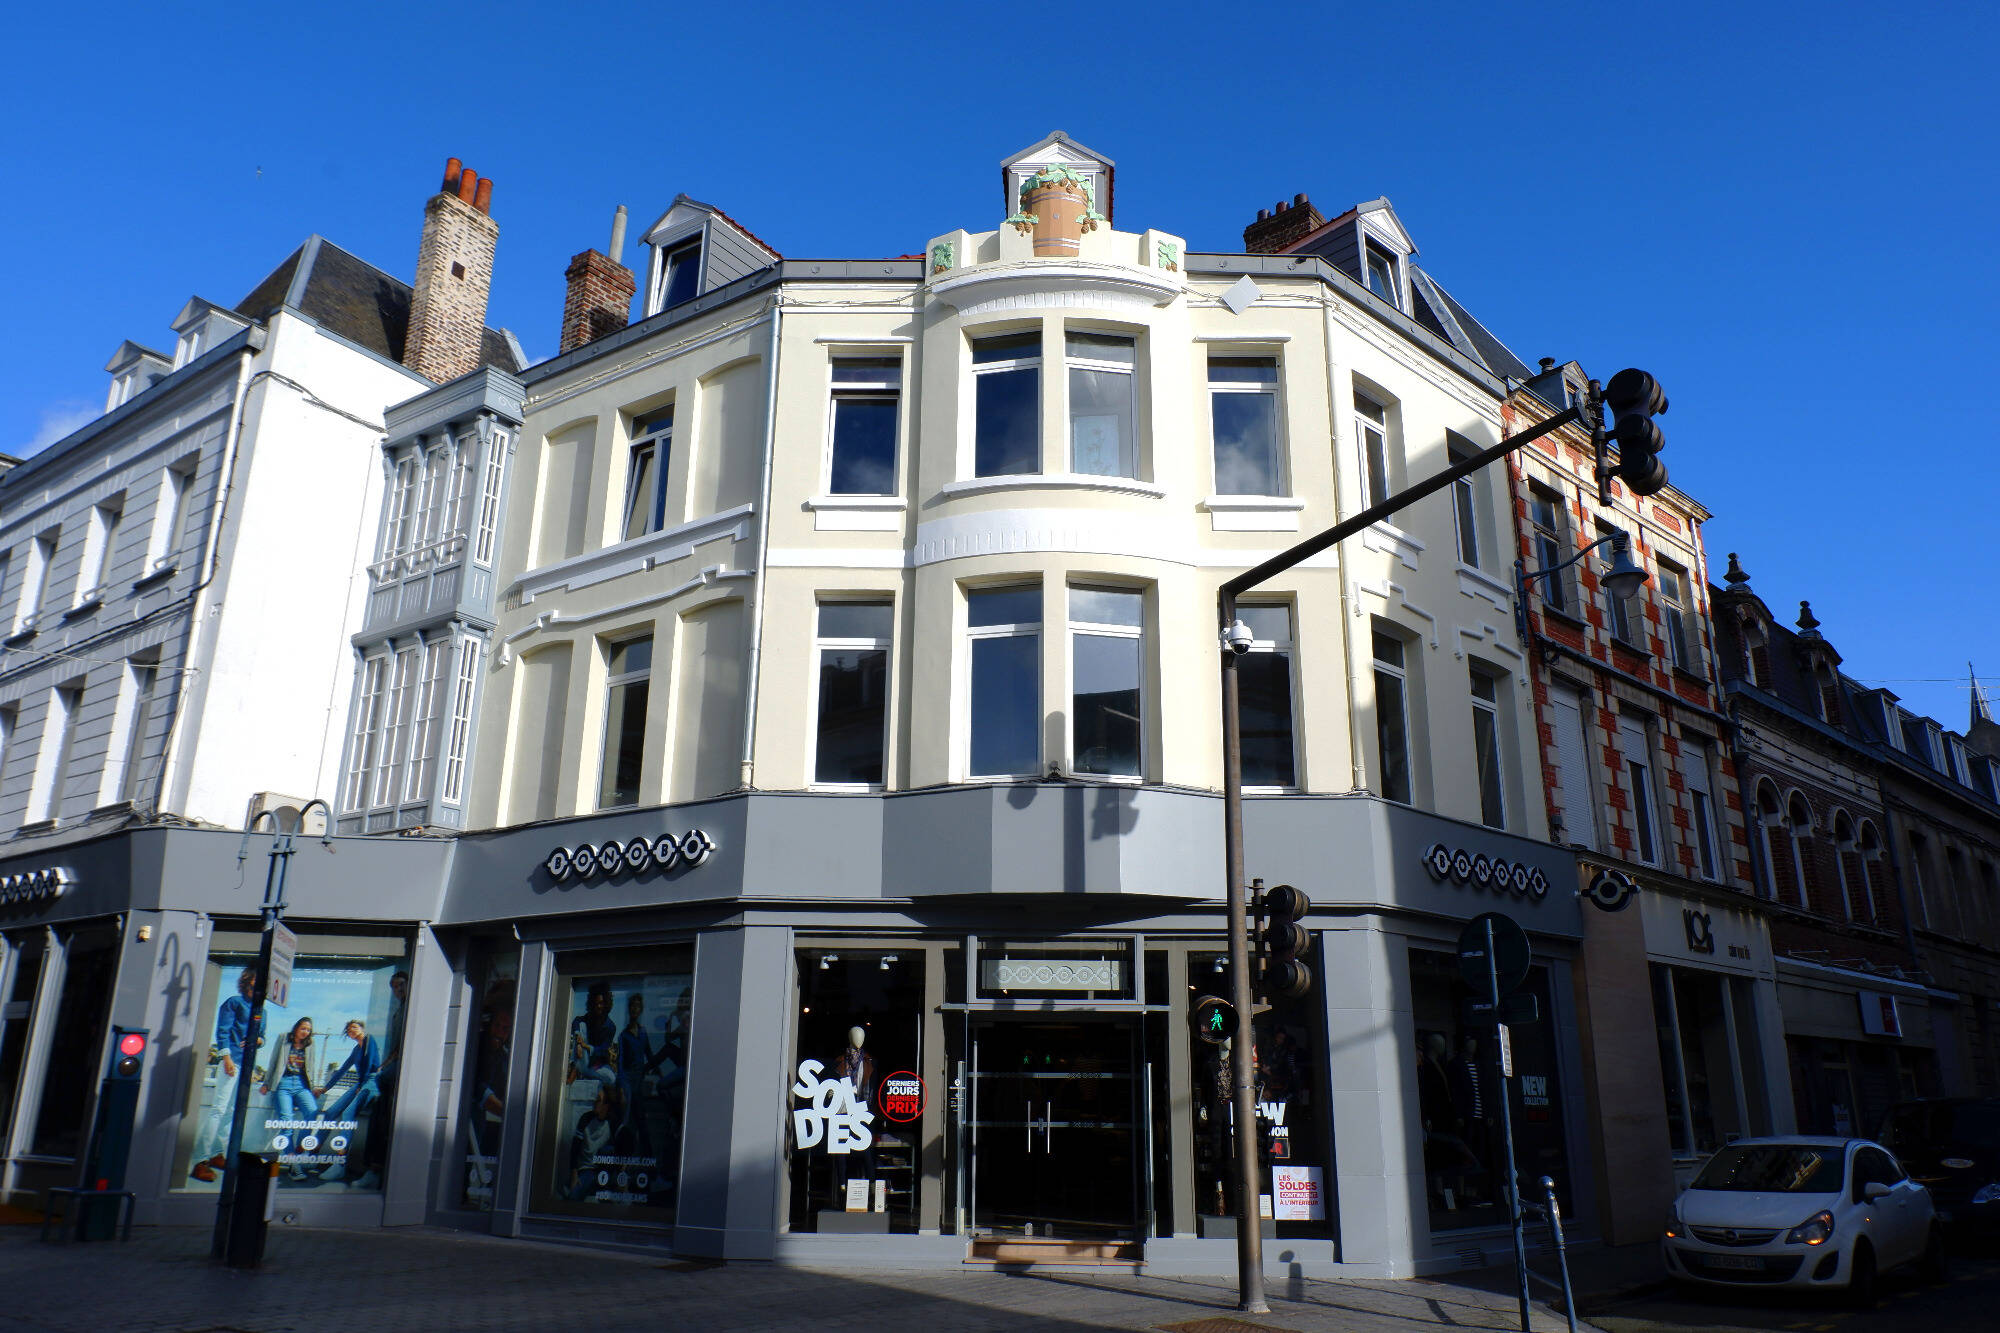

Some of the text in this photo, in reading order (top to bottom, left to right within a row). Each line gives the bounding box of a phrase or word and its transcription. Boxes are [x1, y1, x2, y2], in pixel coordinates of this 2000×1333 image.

[547, 829, 711, 882] BONOBO
[1426, 843, 1549, 901] BONOBO
[887, 1087, 920, 1095] JOURS
[1522, 1075, 1546, 1096] NEW
[886, 1102, 919, 1113] PRIX
[264, 1120, 358, 1130] BONOBOJEANS.COM
[1279, 1182, 1318, 1190] SOLDES
